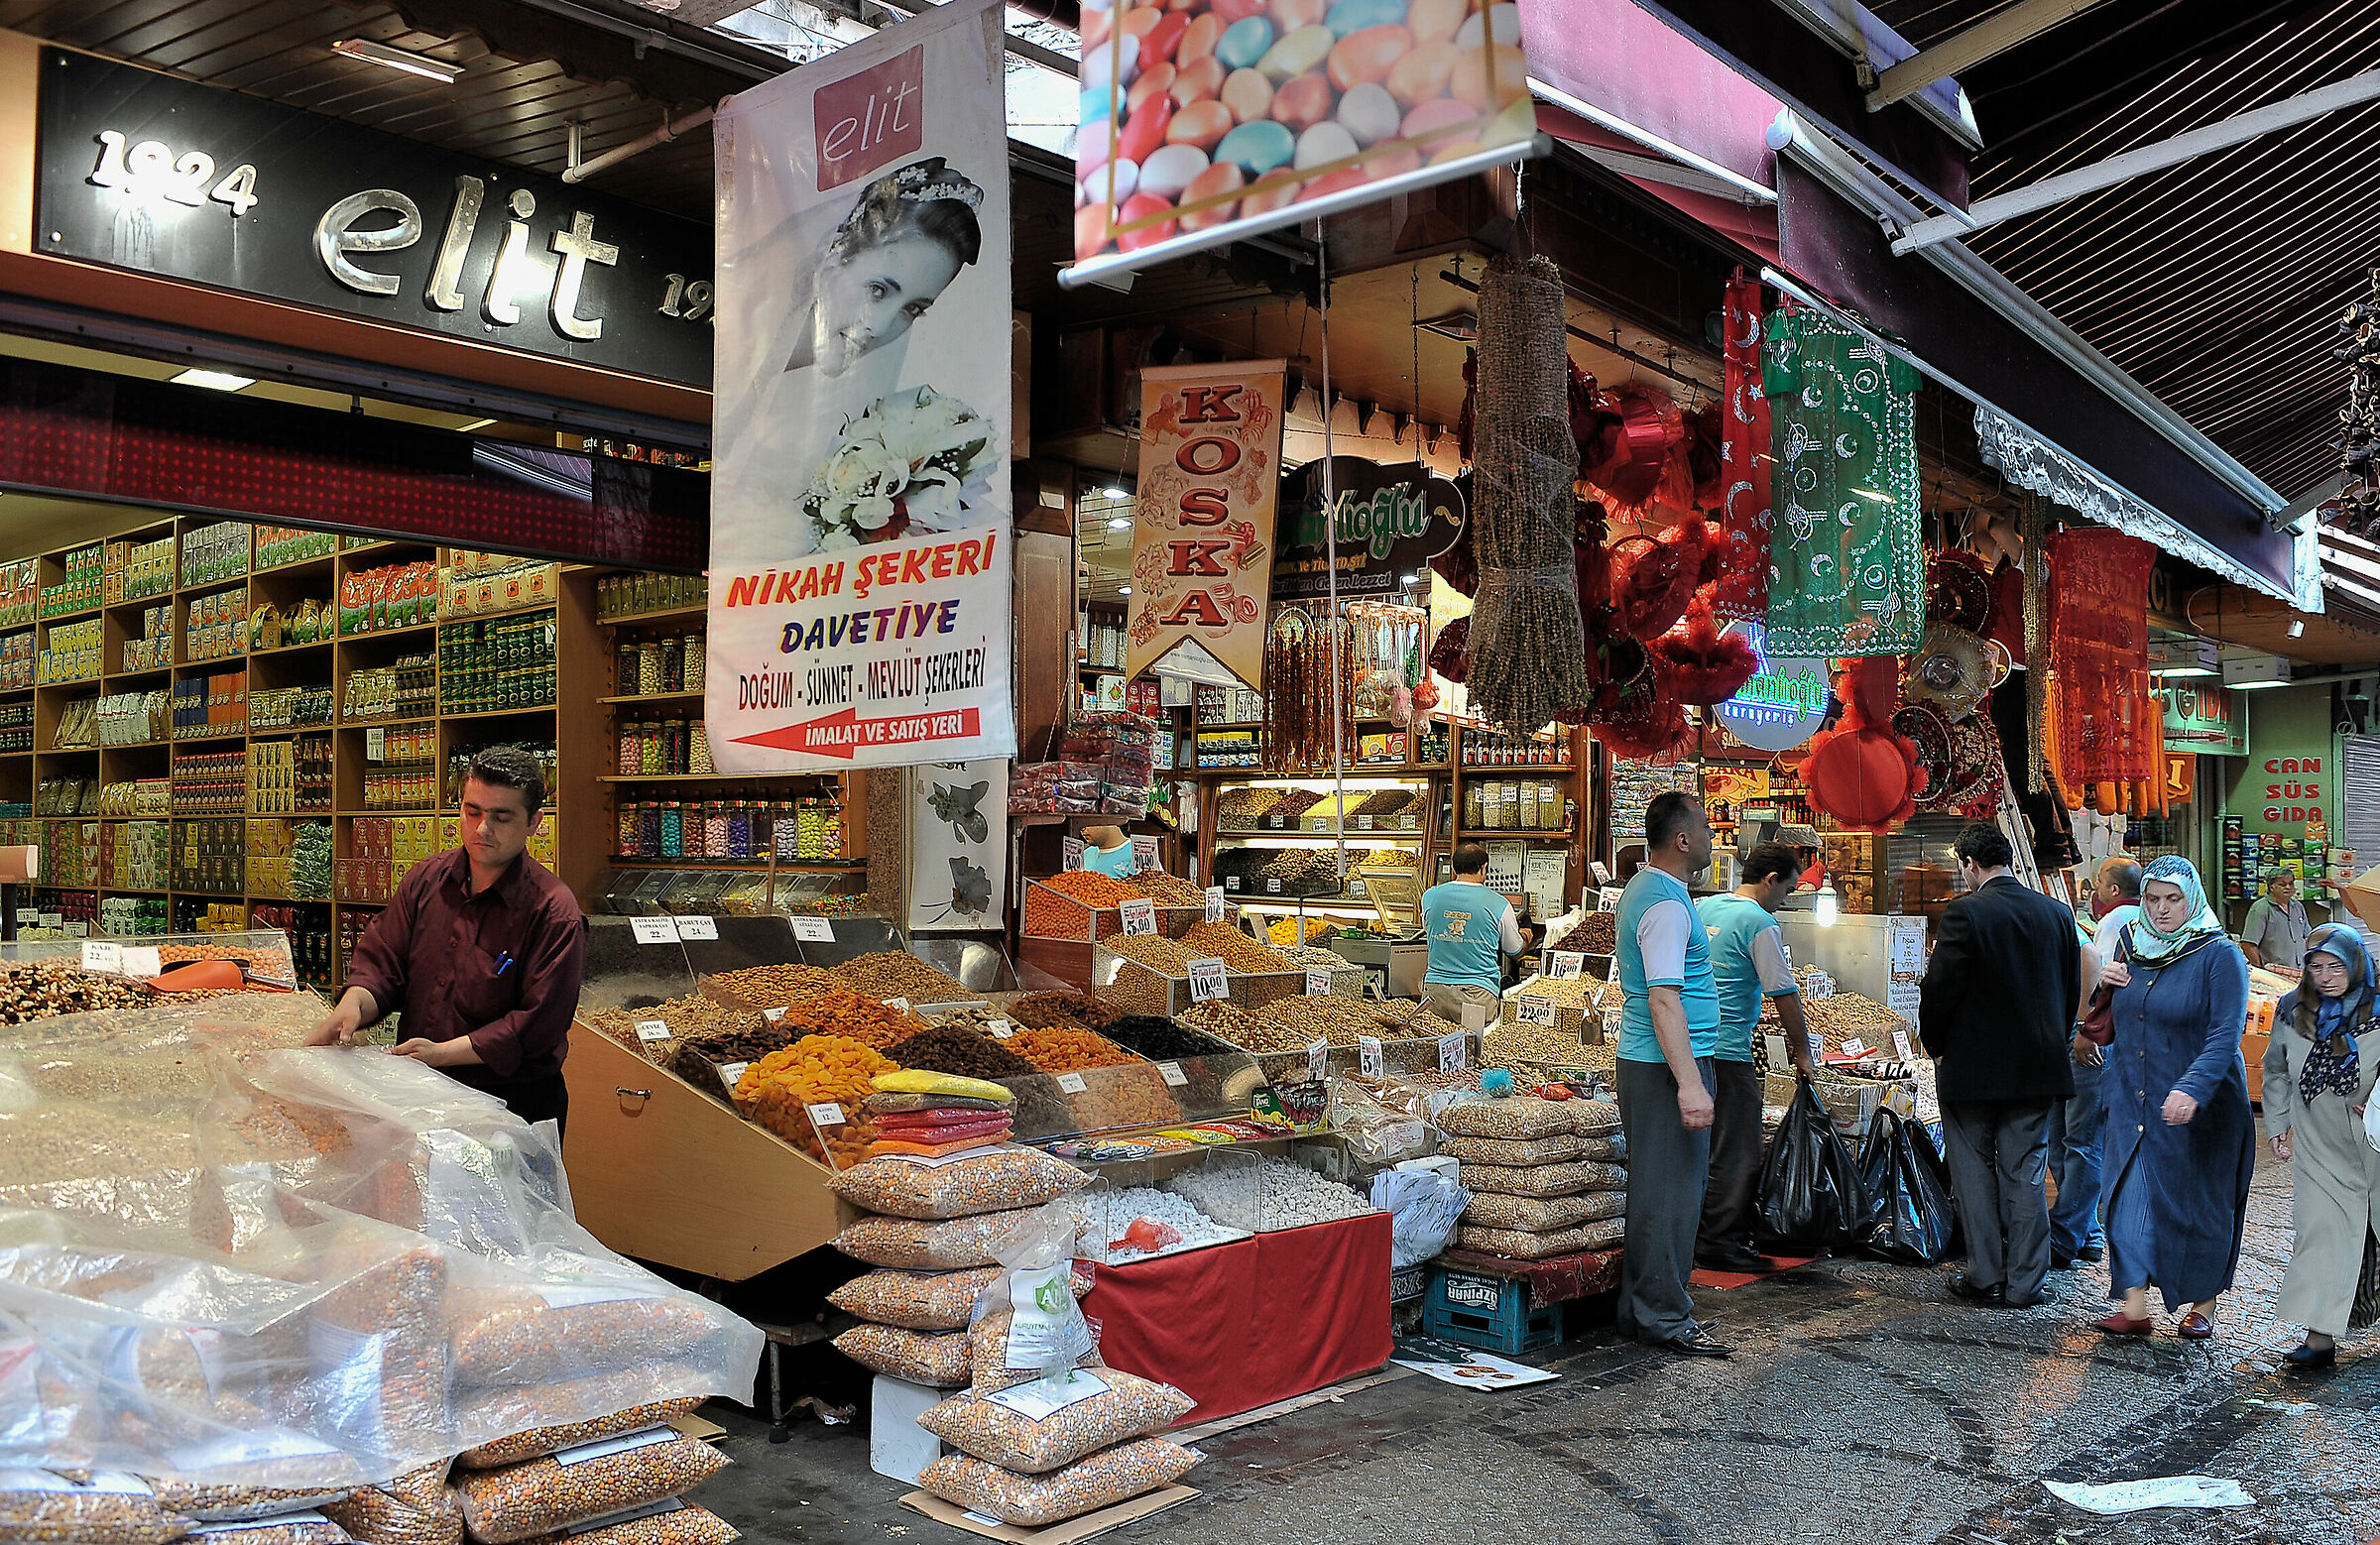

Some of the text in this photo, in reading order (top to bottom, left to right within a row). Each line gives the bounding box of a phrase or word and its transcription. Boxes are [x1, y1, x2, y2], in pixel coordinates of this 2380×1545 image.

[822, 80, 918, 163] elit
[89, 129, 260, 218] 1924
[314, 175, 620, 341] elit
[658, 273, 715, 323] 19
[1159, 384, 1244, 628] KOSKA
[726, 529, 997, 608] NİKAH ŞEKERİ
[779, 599, 961, 654] DAVETİYE
[739, 661, 793, 711] DOĞUM
[806, 657, 854, 707] SÜNNET
[868, 647, 921, 701] MEVLÜT
[924, 635, 987, 707] ŞEKERLERİ
[805, 709, 964, 747] İMALAT VE SATIŞ YERİ
[2263, 757, 2322, 774] CAN
[2265, 779, 2321, 800] SÜS
[2262, 805, 2323, 823] GIDA
